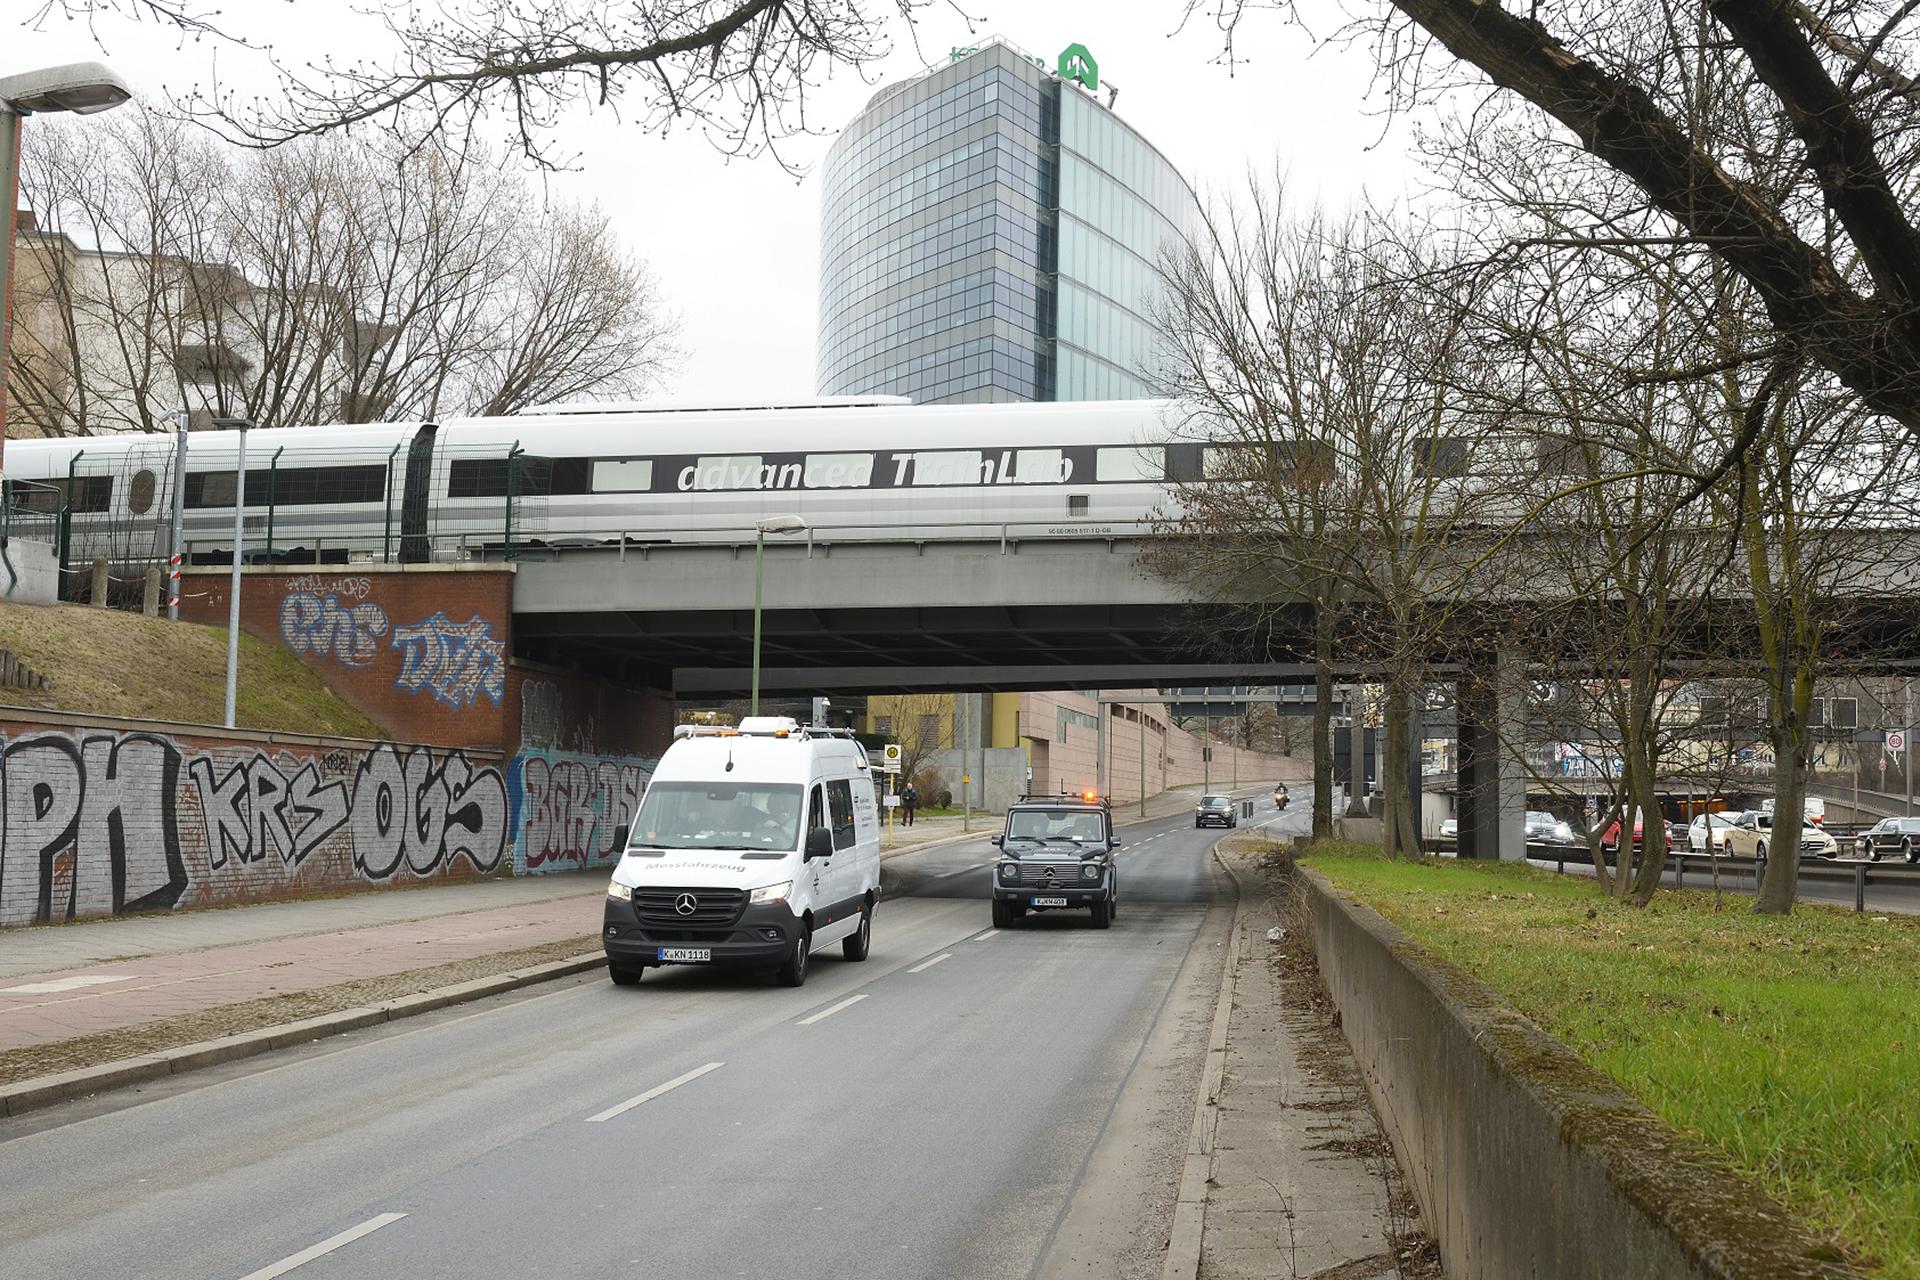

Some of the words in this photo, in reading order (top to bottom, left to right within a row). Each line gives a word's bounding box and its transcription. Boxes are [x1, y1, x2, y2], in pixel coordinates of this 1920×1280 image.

[677, 453, 876, 490] advanced
[891, 450, 1074, 486] TrainLab
[646, 861, 746, 873] Messfahrzeug
[664, 950, 669, 959] K
[674, 950, 686, 959] KN
[688, 950, 709, 959] 1118
